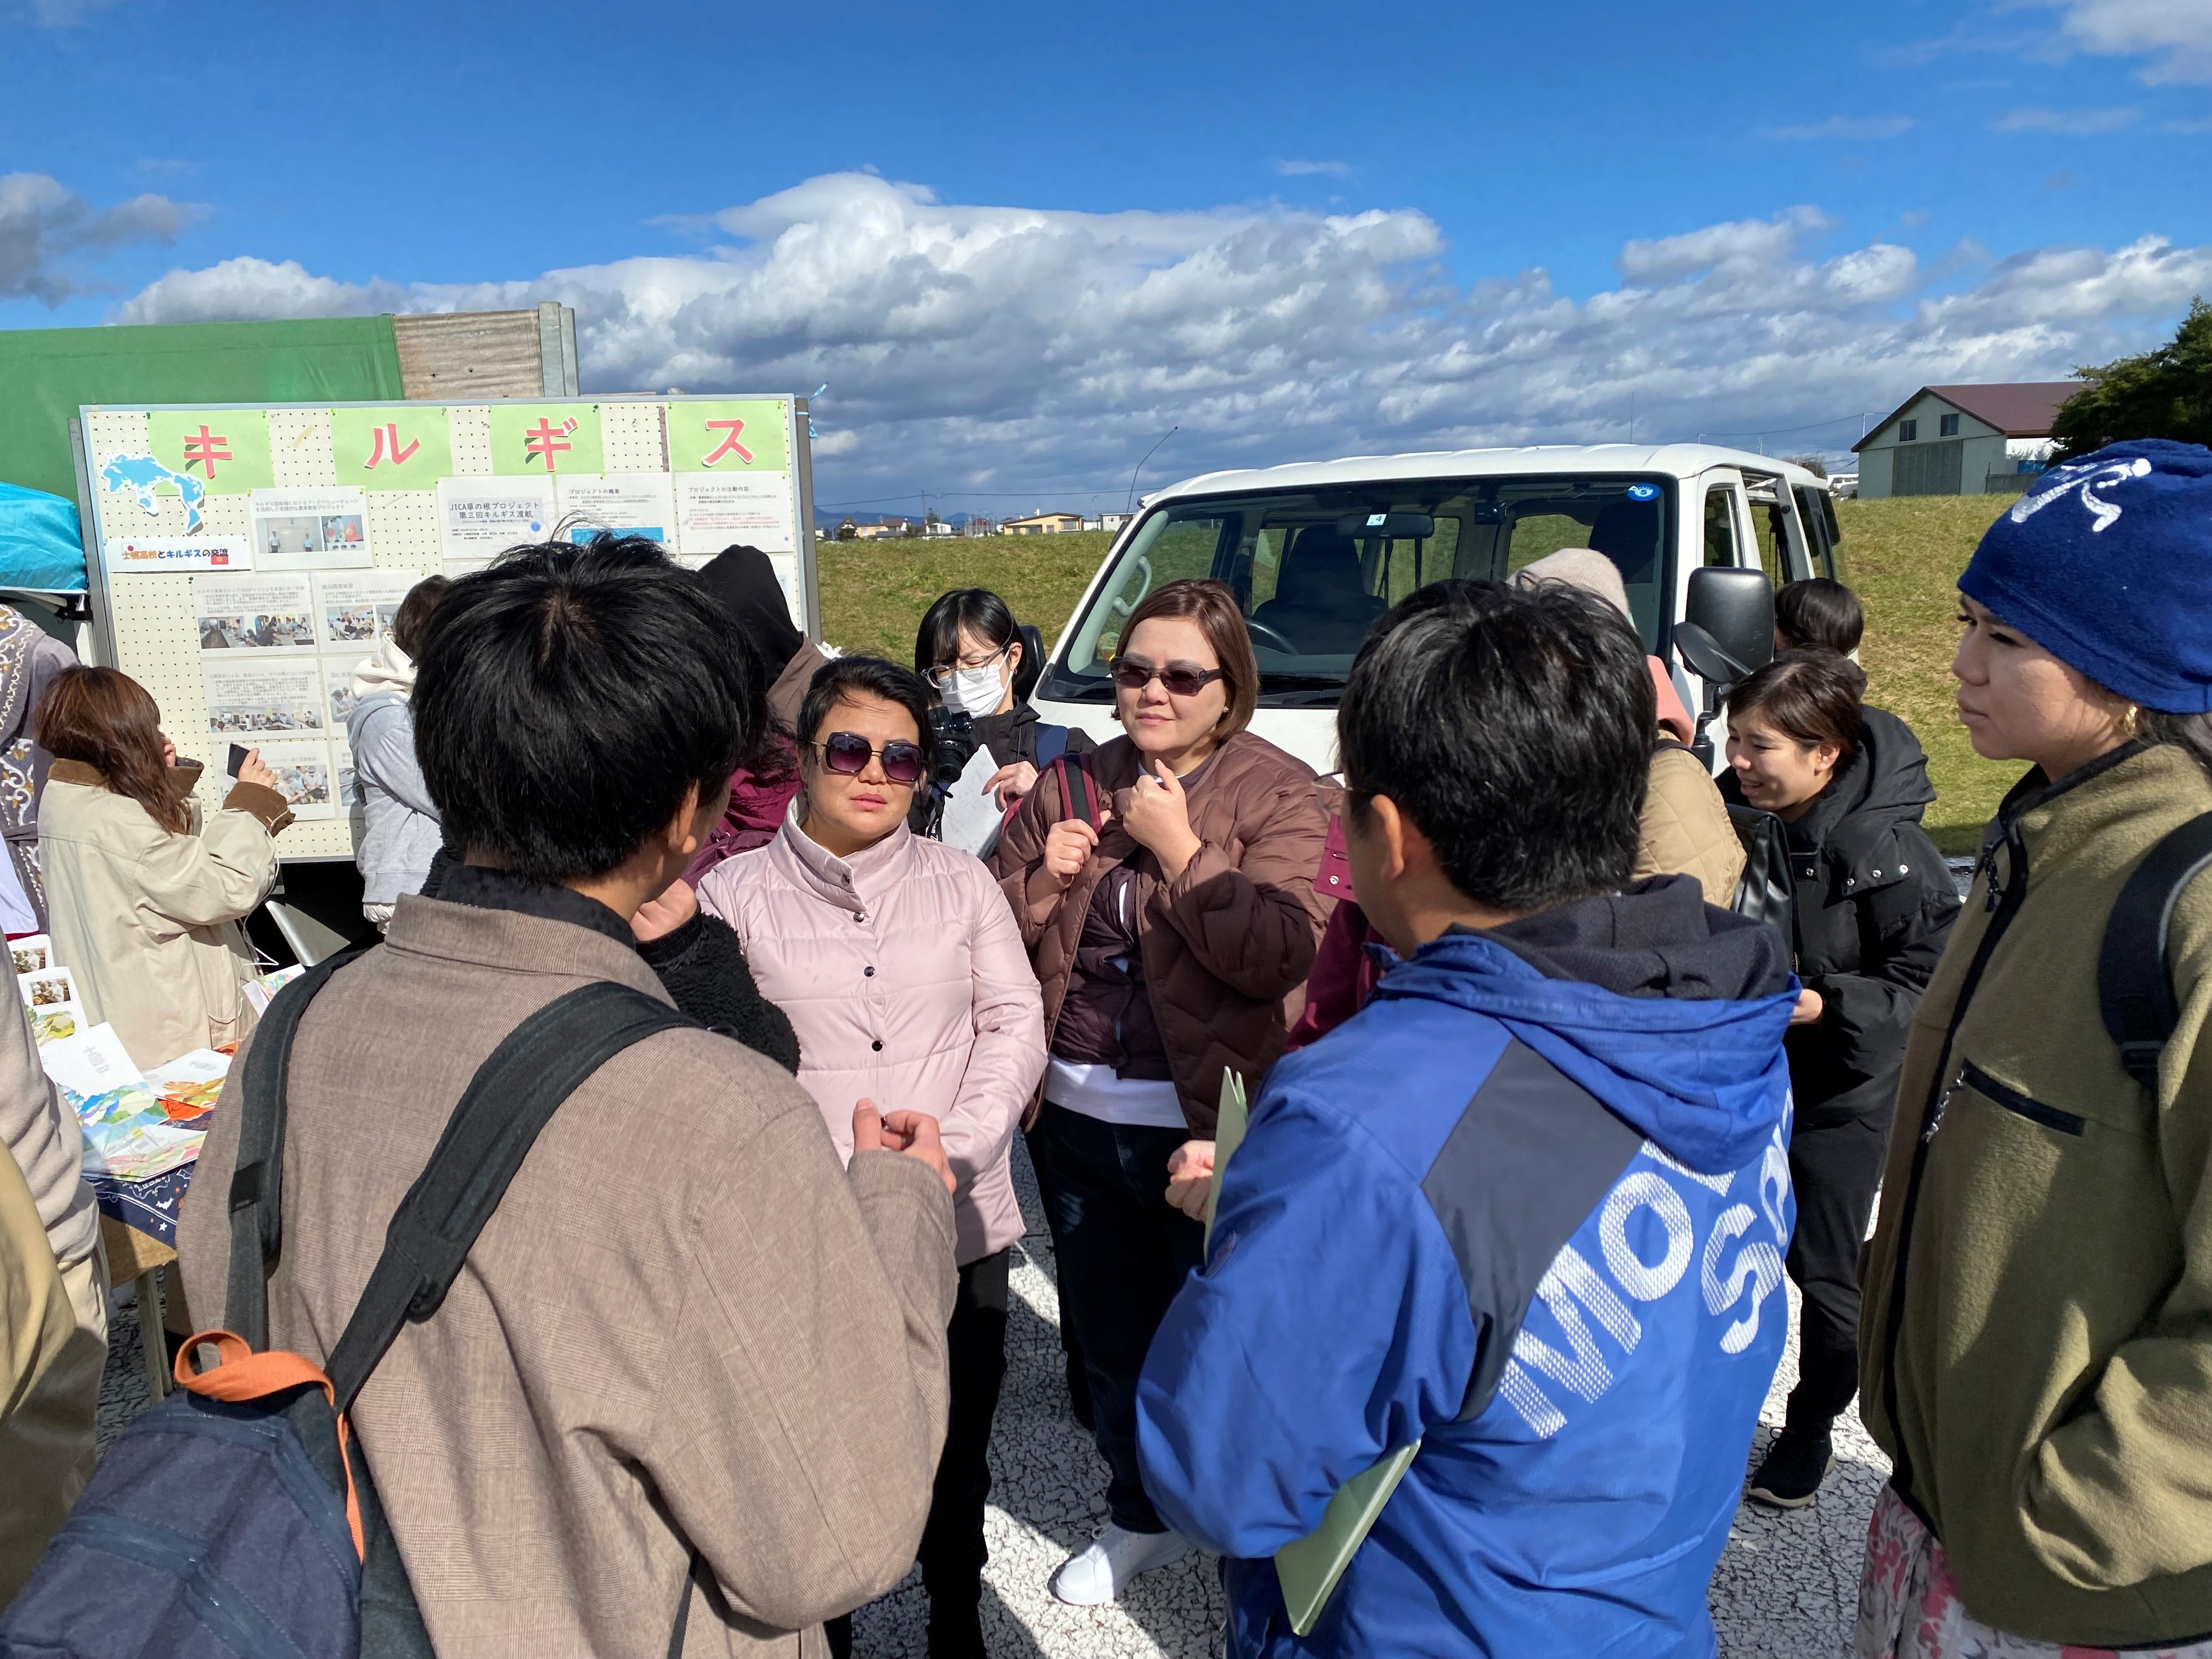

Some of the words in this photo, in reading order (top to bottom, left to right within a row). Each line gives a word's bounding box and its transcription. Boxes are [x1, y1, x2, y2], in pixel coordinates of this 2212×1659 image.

[183, 417, 755, 479] キルギス
[450, 501, 539, 511] JICA草の根プロジェクト
[459, 510, 533, 519] 第三回キルギス渡航
